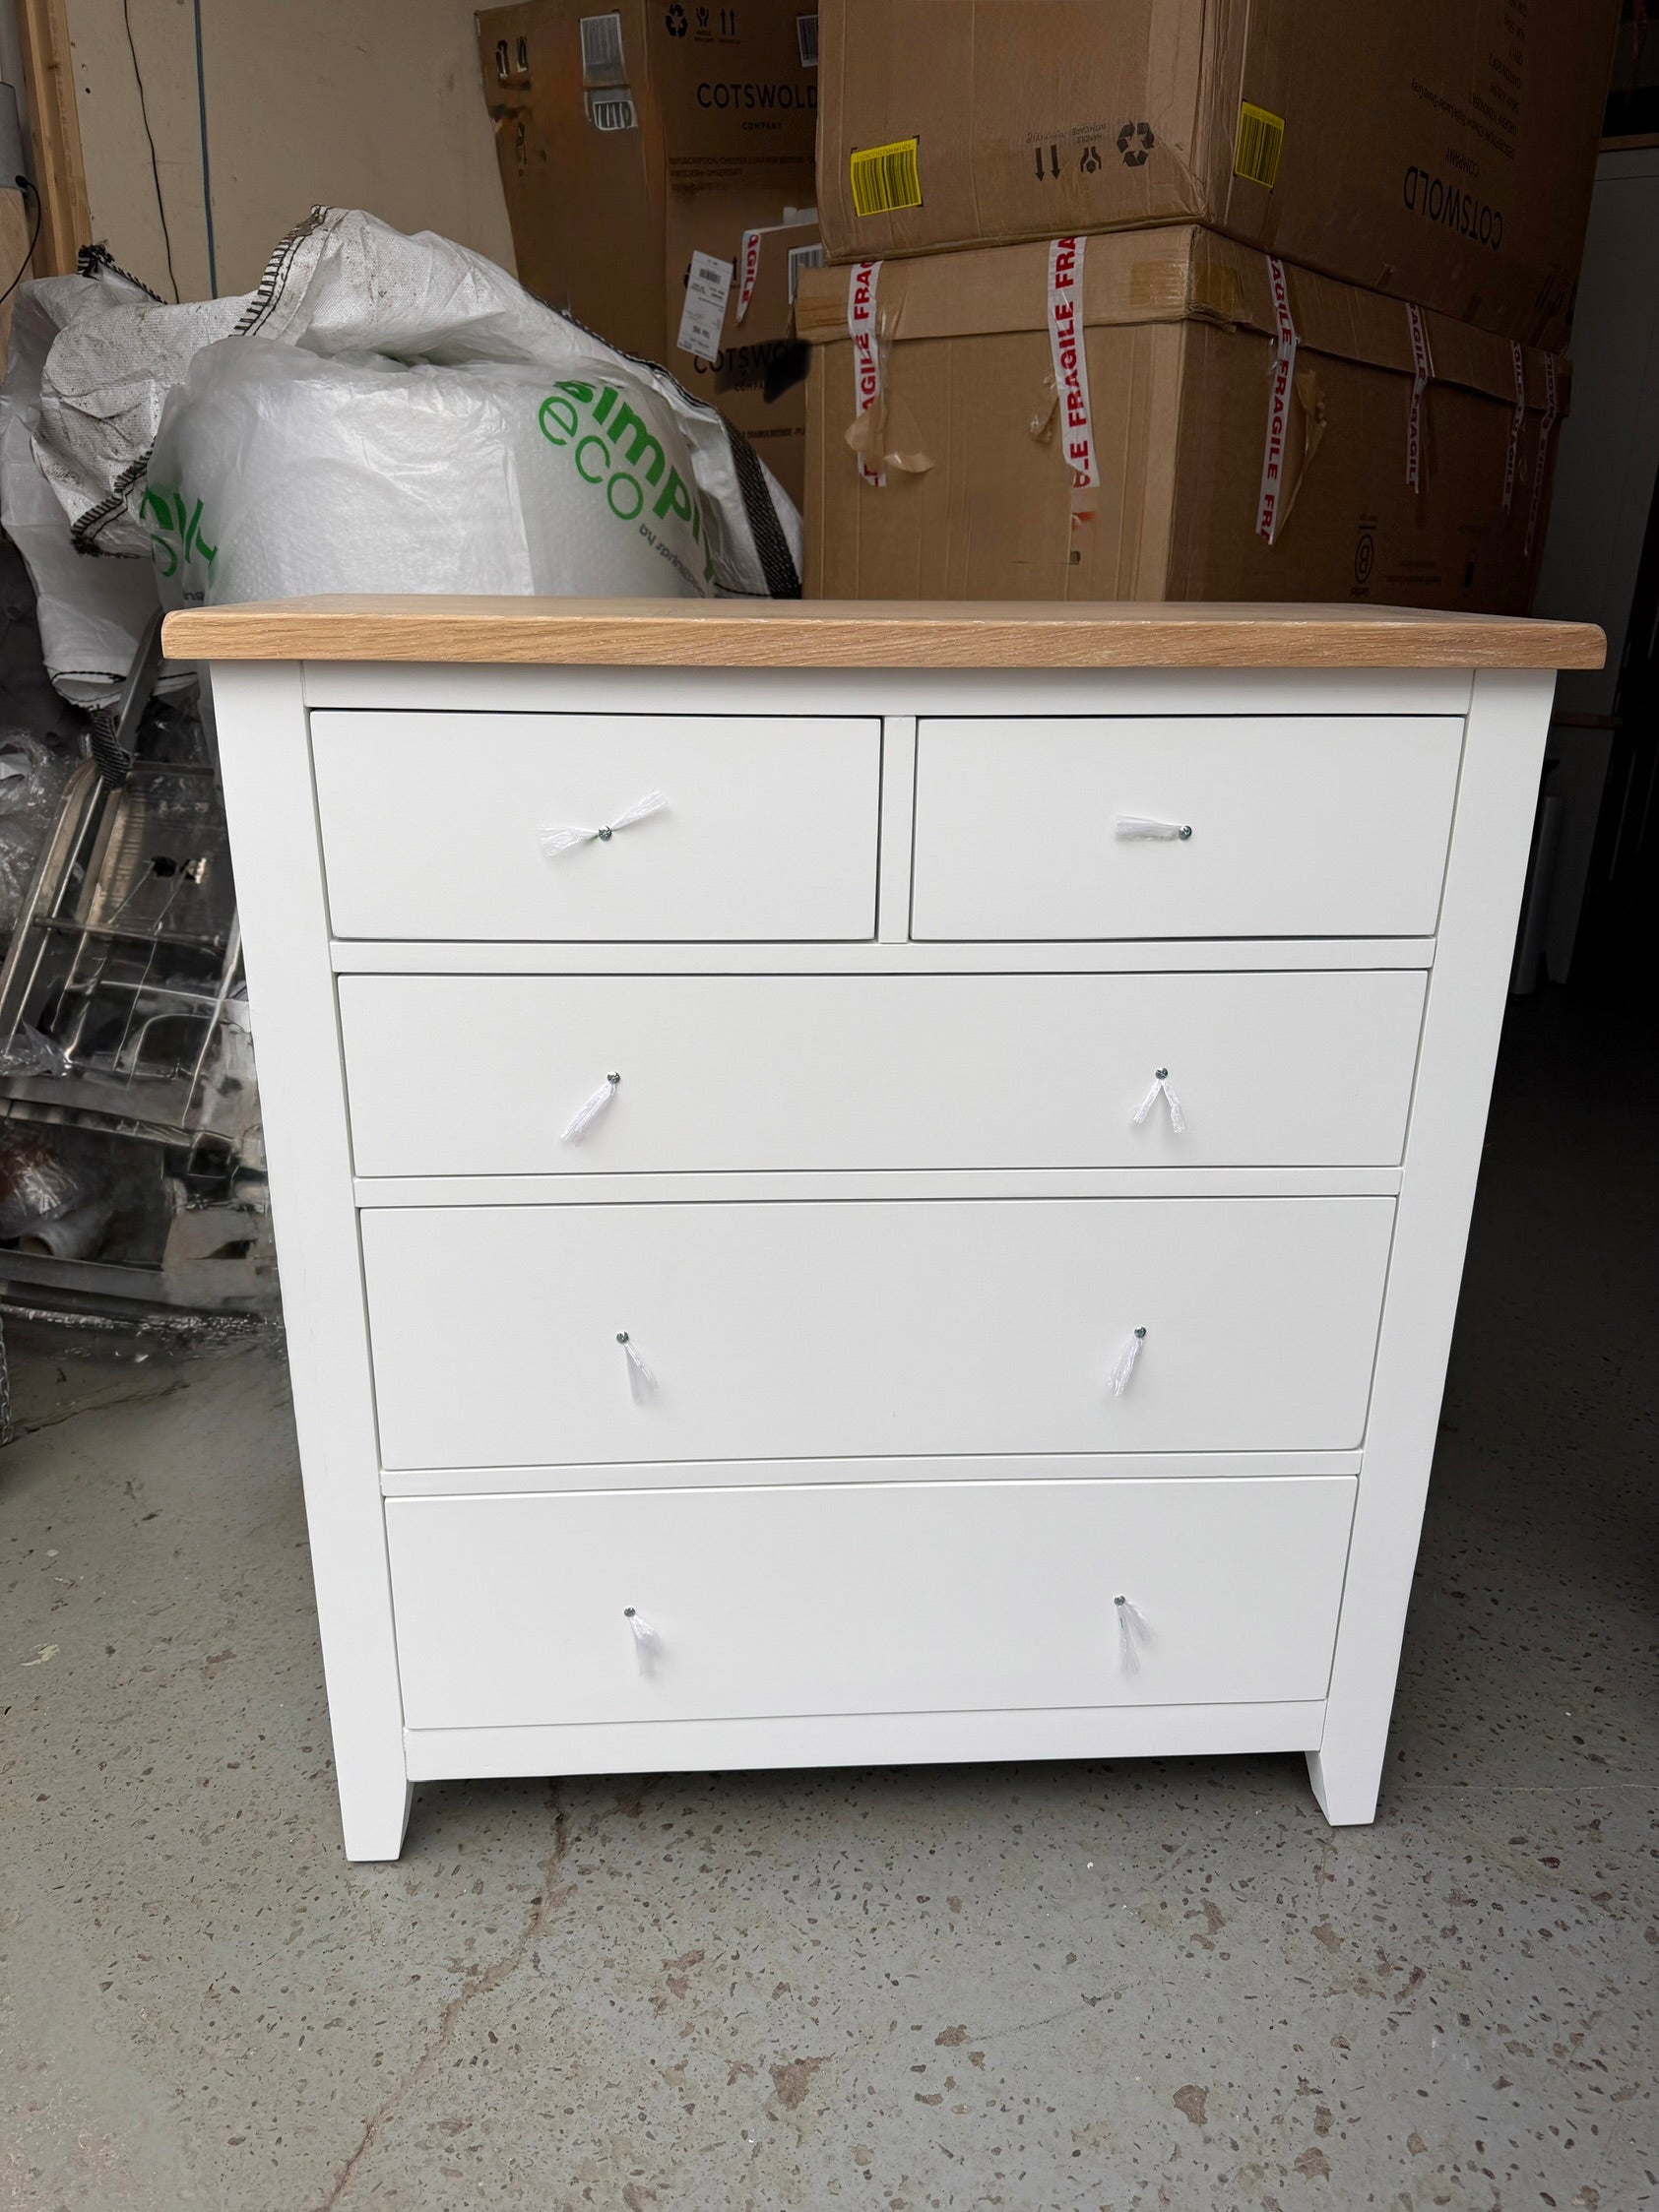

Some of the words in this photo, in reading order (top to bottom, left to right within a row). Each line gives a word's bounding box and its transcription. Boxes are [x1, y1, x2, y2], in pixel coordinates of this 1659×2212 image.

[696, 82, 818, 109] COTSWOLD
[741, 121, 783, 131] COMPANY
[1444, 146, 1480, 178] COMPANY
[1402, 165, 1503, 251] COTSWOLD
[1054, 300, 1087, 427] FRAGILE
[538, 396, 645, 521] eco
[1267, 359, 1290, 480] FRAGILE
